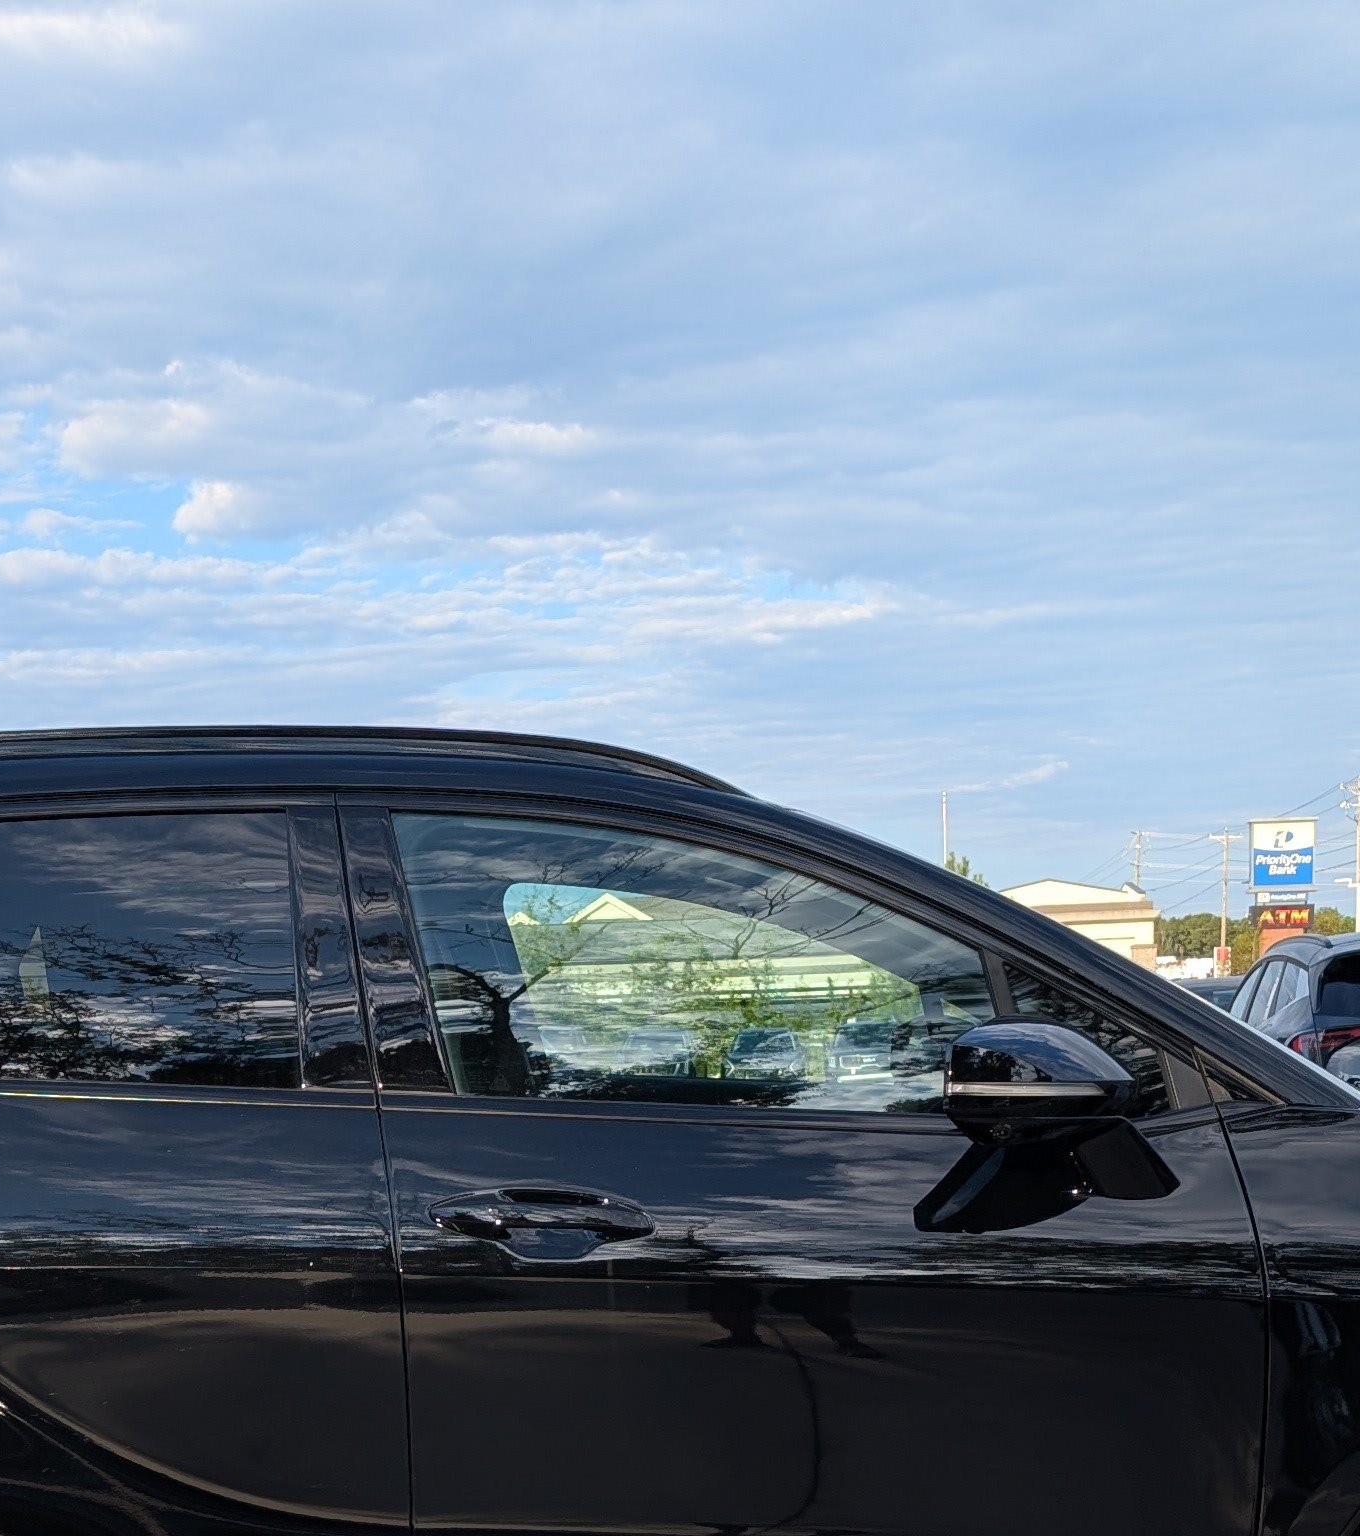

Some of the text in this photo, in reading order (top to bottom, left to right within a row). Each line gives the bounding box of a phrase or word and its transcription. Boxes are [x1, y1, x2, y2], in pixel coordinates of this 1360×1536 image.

[1255, 853, 1312, 867] PriorityOne
[1268, 864, 1297, 875] Bank
[1257, 907, 1310, 925] ATM
